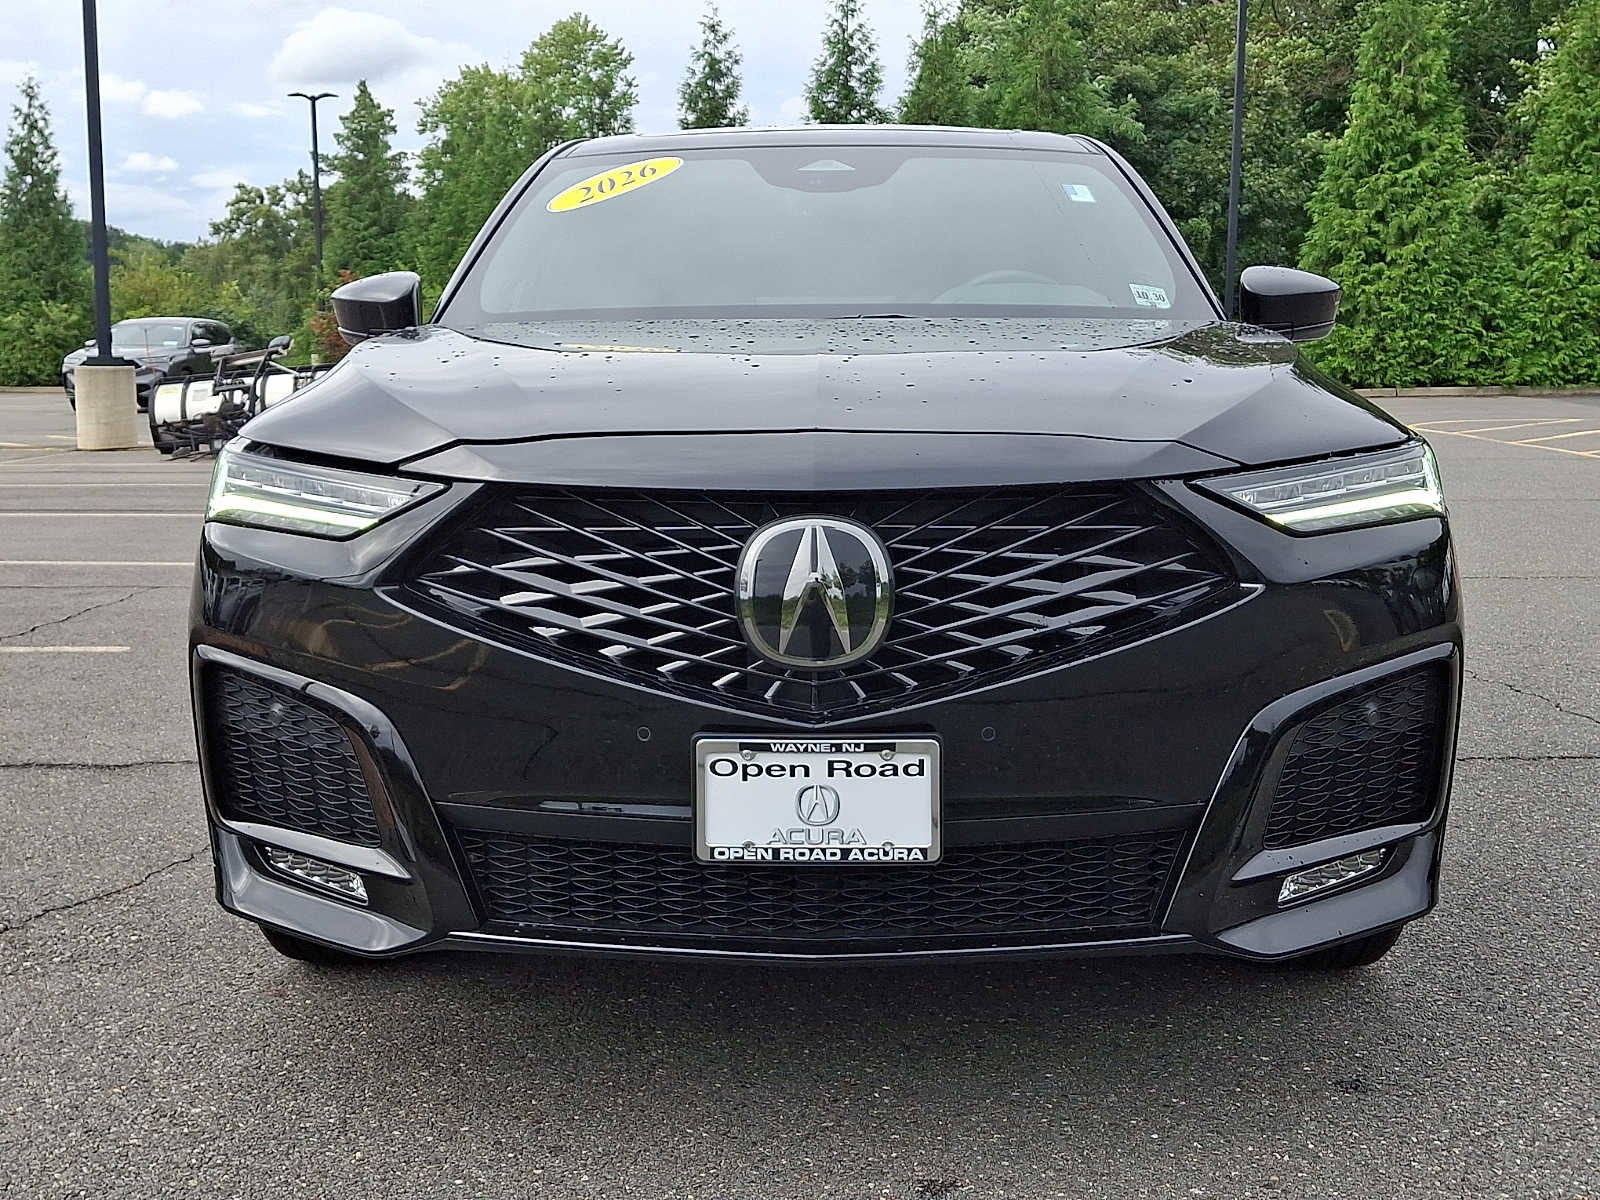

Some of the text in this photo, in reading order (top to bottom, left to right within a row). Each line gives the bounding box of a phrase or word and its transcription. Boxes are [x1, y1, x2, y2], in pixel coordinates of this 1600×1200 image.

[578, 164, 657, 204] 2026
[770, 743, 865, 753] WAYNE, NJ
[709, 758, 925, 782] Open Road
[767, 828, 867, 845] ACURA
[713, 847, 925, 861] OPEN ROAD ACURA
